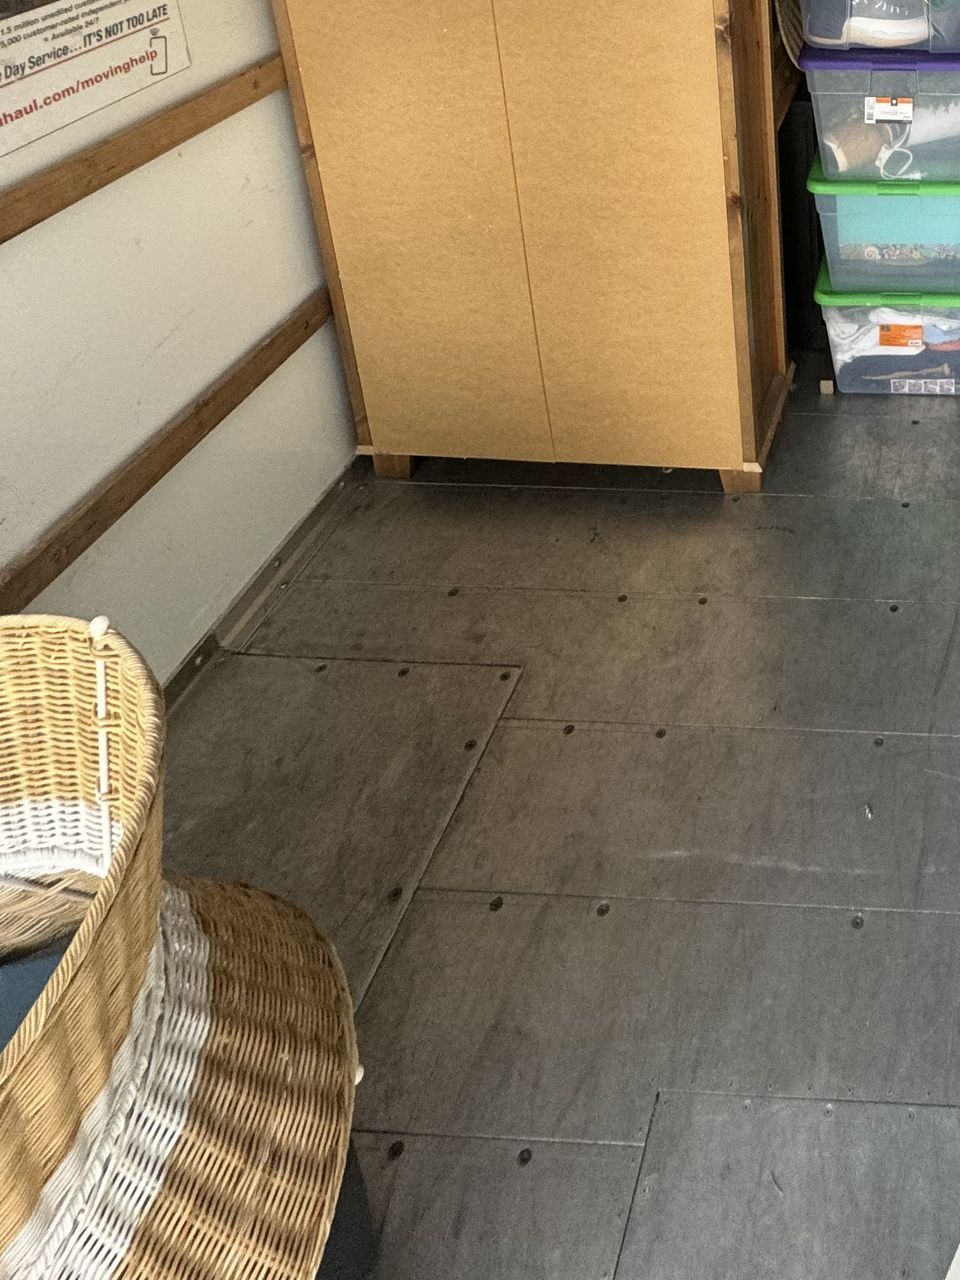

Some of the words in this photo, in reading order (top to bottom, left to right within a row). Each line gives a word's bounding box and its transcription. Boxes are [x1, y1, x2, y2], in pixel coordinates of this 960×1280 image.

[14, 18, 39, 31] million
[41, 4, 73, 22] unedited
[23, 12, 80, 40] customer-rated
[81, 0, 122, 18] independent
[51, 23, 83, 40] Available
[85, 16, 99, 28] 24/7
[4, 62, 26, 79] Day
[83, 29, 103, 48] IT'S
[105, 20, 124, 39] NOT
[126, 13, 144, 30] TOO
[146, 4, 168, 22] LATE
